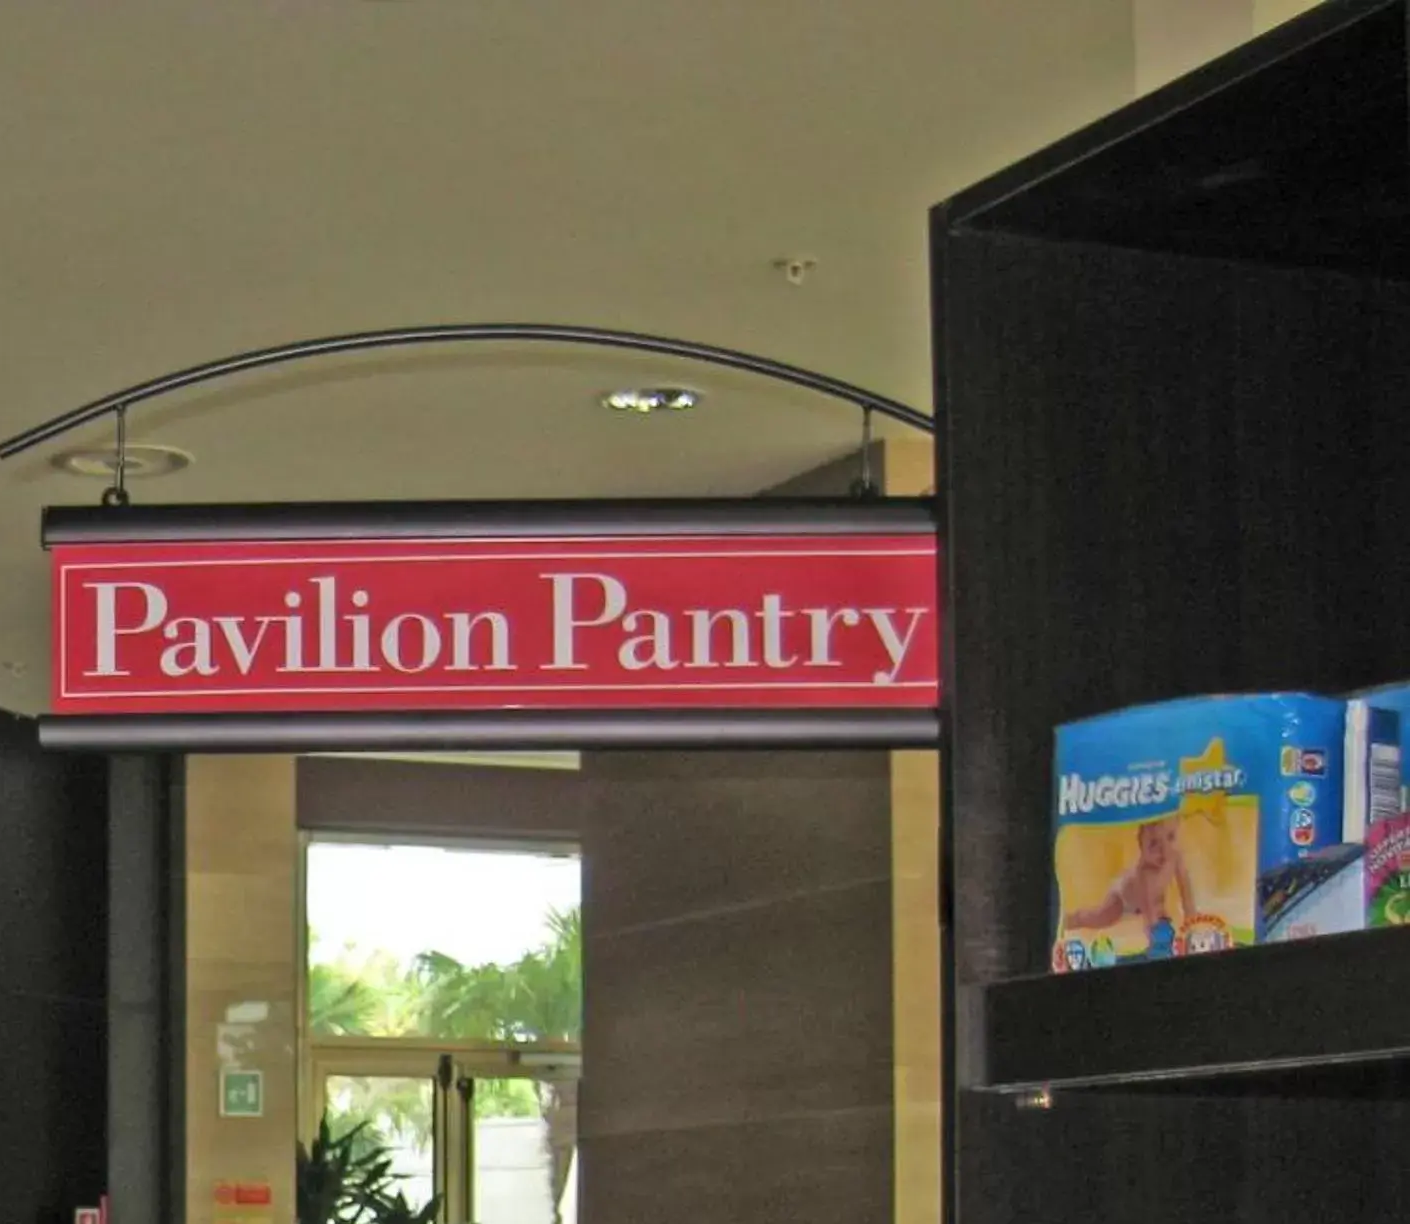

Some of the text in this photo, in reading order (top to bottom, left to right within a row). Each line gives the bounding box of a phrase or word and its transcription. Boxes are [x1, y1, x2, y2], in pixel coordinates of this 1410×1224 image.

[82, 571, 930, 685] Pavilion Pantry
[1058, 772, 1172, 816] HUGGIES
